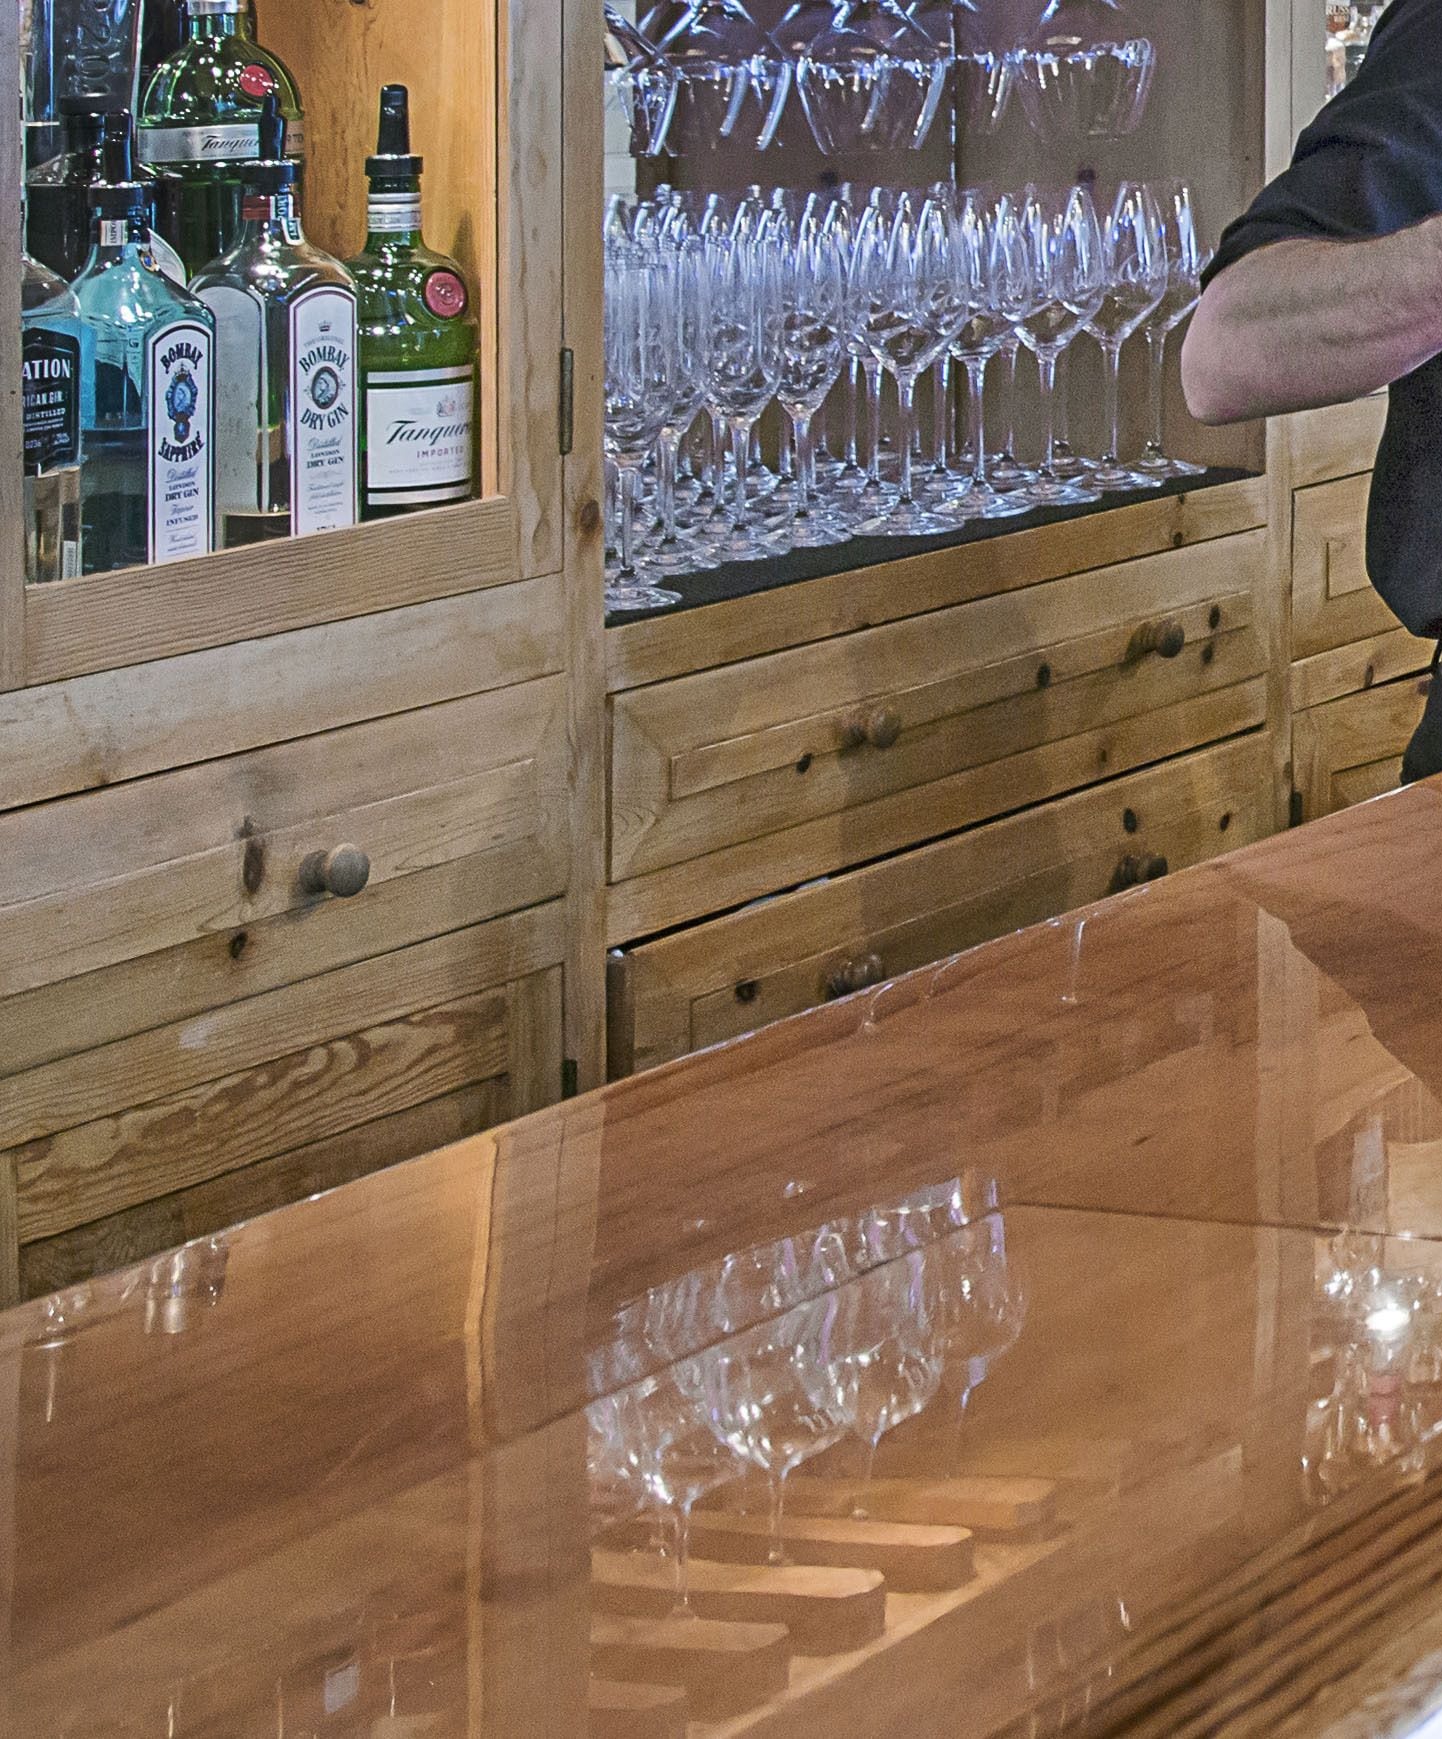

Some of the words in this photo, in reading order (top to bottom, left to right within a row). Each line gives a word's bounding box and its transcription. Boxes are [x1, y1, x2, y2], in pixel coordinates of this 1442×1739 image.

[160, 342, 204, 374] BOMBAY
[298, 345, 350, 375] BOMBAY
[300, 407, 326, 431] DRY
[327, 402, 349, 428] GIN
[158, 430, 205, 462] SAPPHIRE
[416, 446, 464, 459] IMPORTED
[307, 459, 324, 469] DRY
[328, 456, 344, 467] GIN
[165, 491, 182, 502] DRY
[183, 488, 200, 499] GIN
